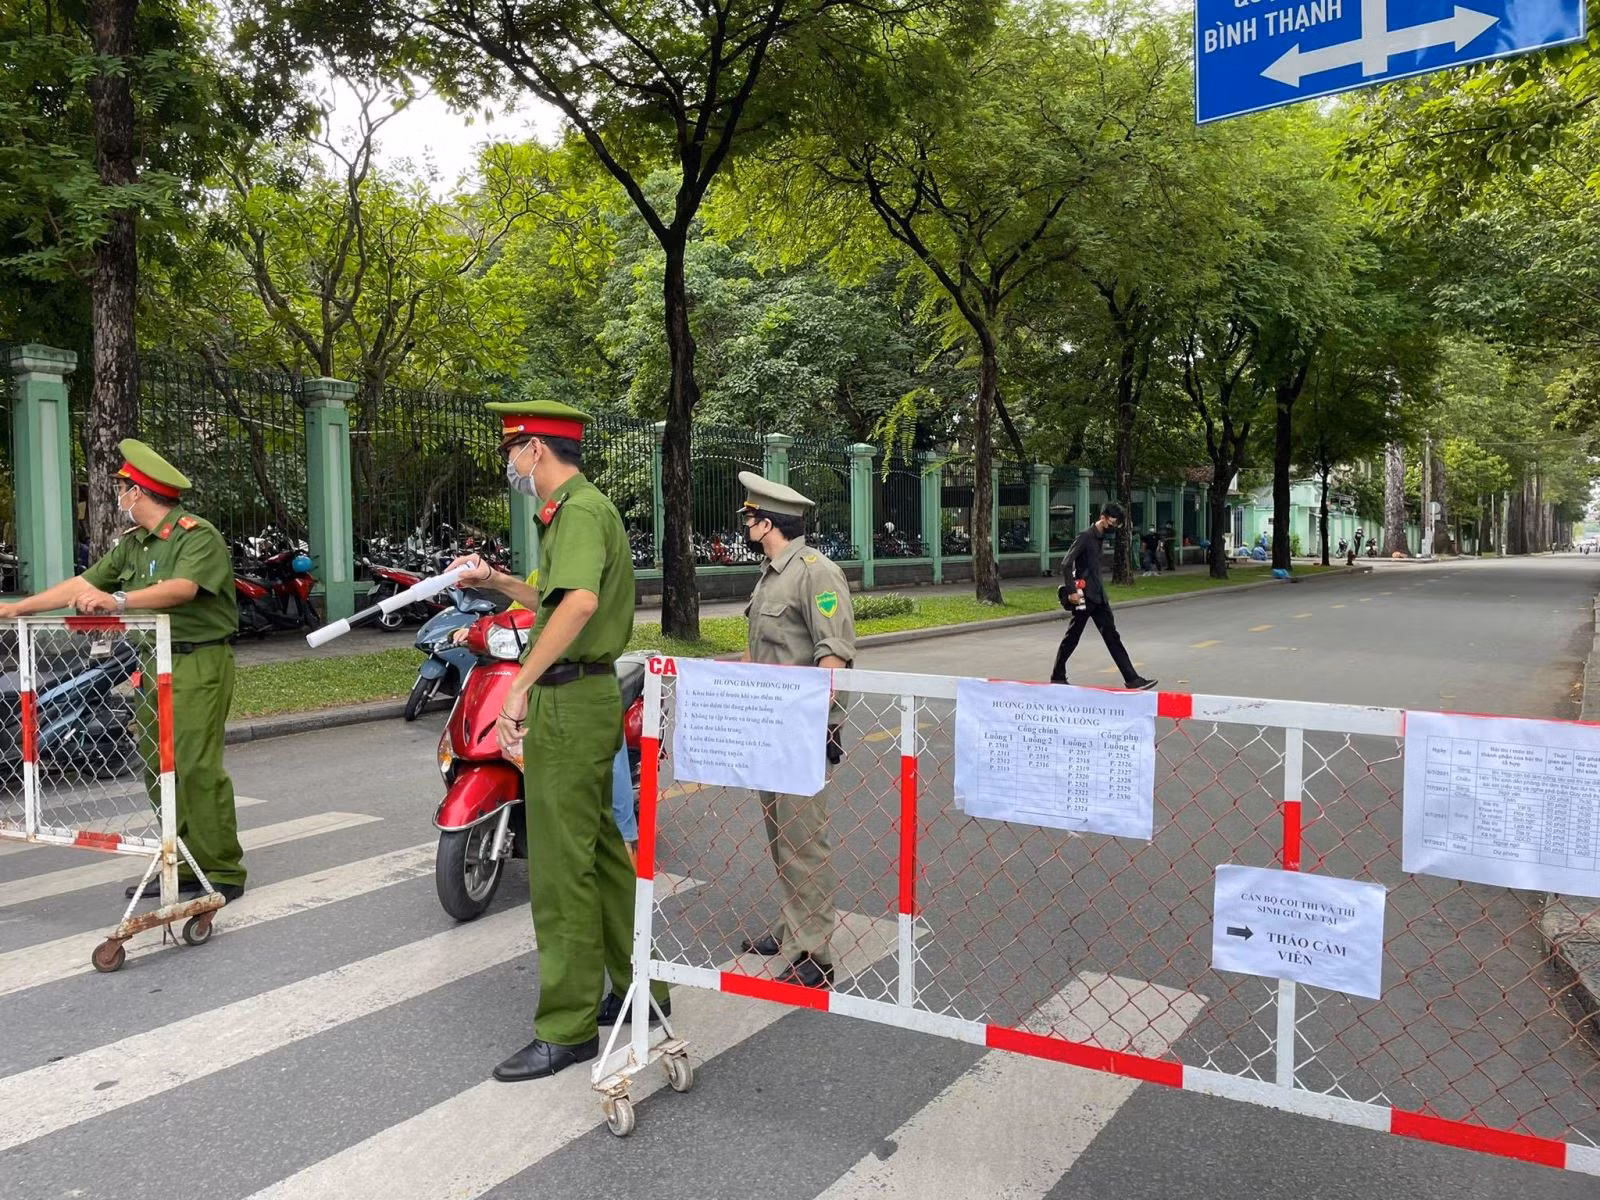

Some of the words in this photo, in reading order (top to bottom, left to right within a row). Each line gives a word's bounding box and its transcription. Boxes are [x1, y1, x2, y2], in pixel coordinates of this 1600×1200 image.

[1204, 17, 1257, 54] BÌNH
[1264, 0, 1342, 37] THẠNH
[649, 657, 677, 675] CA
[1046, 704, 1058, 712] RA
[1061, 703, 1080, 714] VÀO
[1109, 708, 1125, 717] THI
[1038, 725, 1059, 735] chính
[1047, 737, 1053, 745] 2
[1088, 740, 1093, 748] 3
[1241, 892, 1261, 902] CÁN
[1264, 894, 1278, 905] BỘ
[1280, 898, 1298, 908] COI
[1300, 901, 1318, 911] THI
[1320, 903, 1335, 914] VÀ
[1257, 905, 1280, 916] SINH
[1304, 912, 1318, 921] XE
[1320, 915, 1337, 926] TẠI
[1267, 931, 1309, 948] THẢO
[1277, 950, 1312, 966] VIÊN
